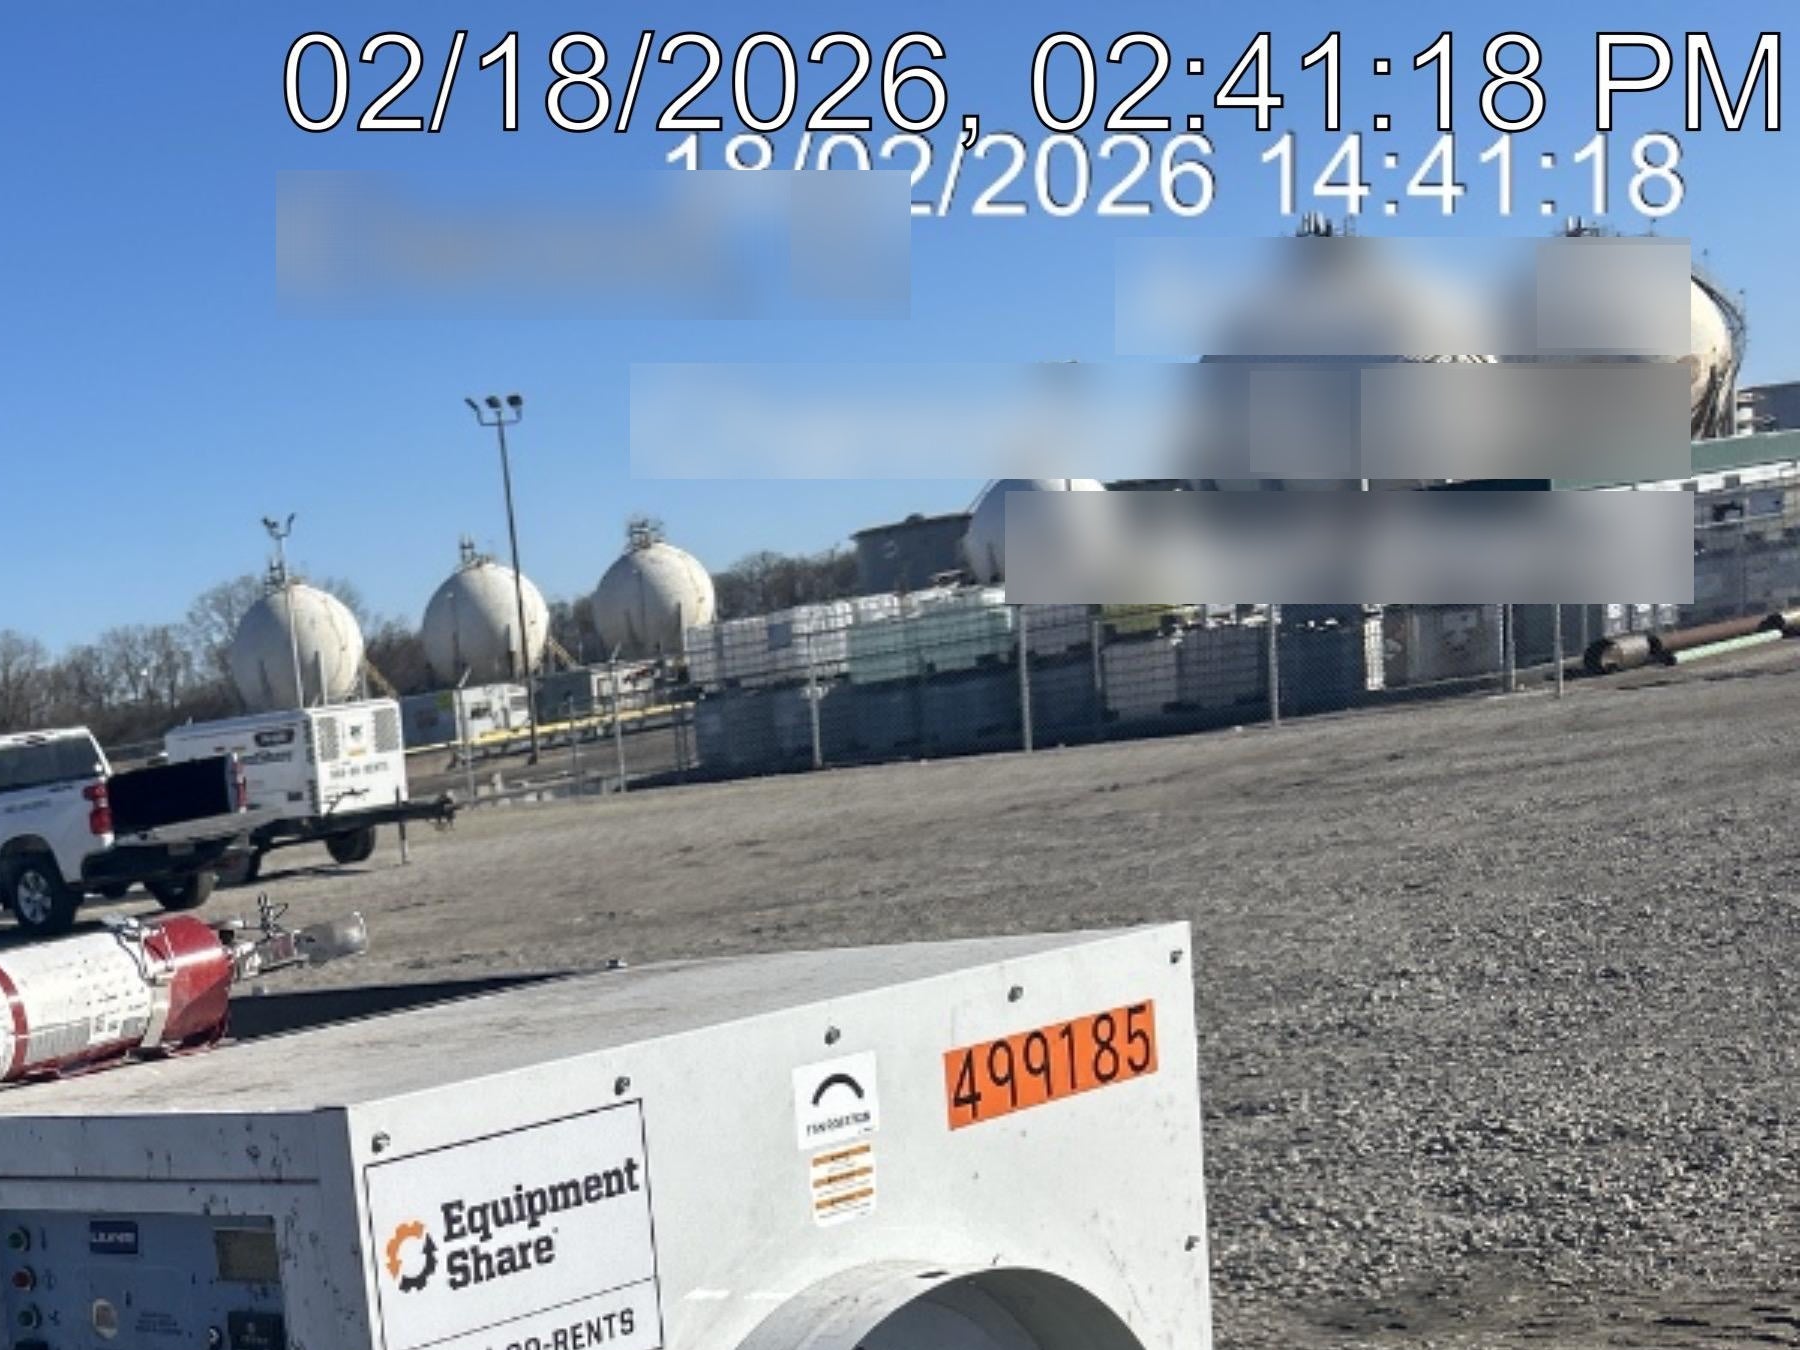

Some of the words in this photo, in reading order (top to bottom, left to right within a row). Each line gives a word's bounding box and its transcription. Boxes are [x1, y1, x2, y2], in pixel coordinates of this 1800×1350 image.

[953, 1004, 1150, 1120] 499185
[440, 1157, 640, 1242] Equipment
[446, 1234, 556, 1291] Share
